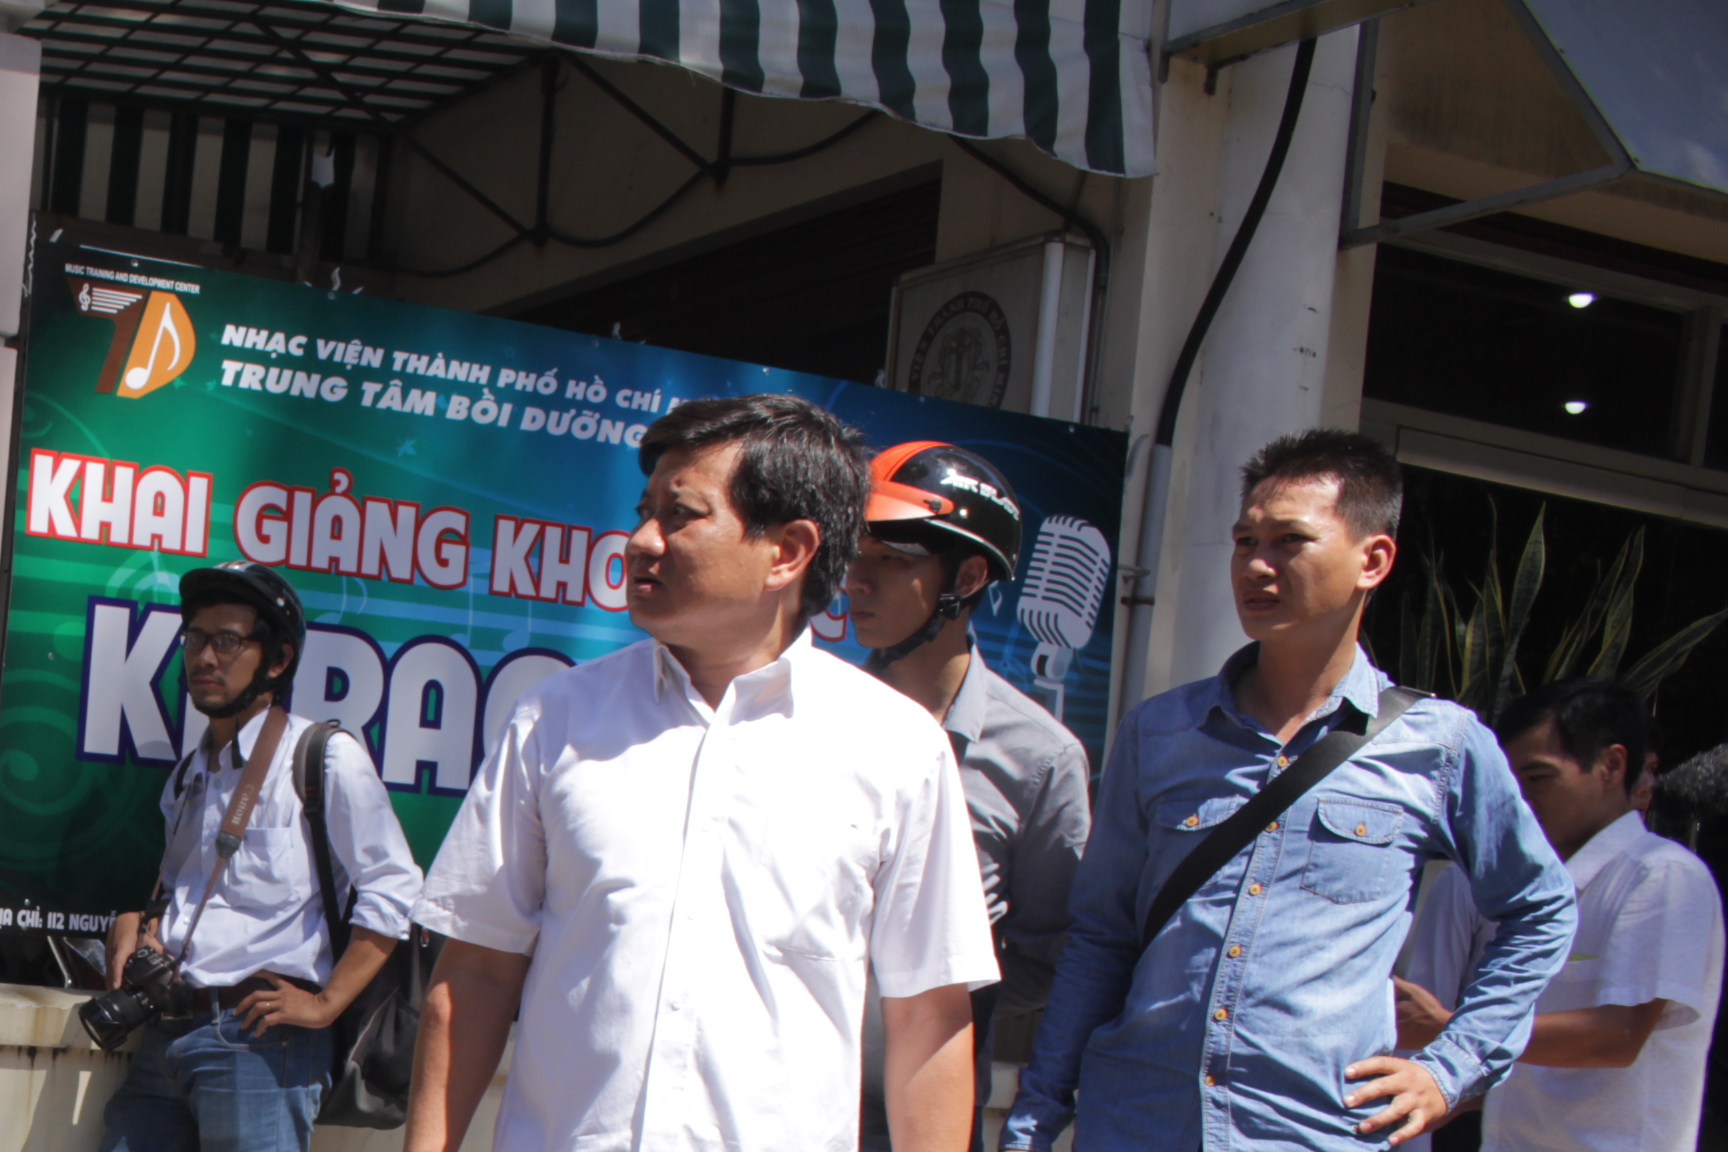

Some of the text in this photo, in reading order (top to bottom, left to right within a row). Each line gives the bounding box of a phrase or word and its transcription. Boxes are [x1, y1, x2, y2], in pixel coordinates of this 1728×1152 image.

[65, 263, 201, 295] MUSIC TRAINING AND DEVELOPMENT CENTER
[221, 323, 309, 359] NHẠC
[316, 338, 385, 371] VIỆN
[392, 352, 492, 385] THÀNH
[497, 367, 559, 396] PHỐ
[565, 374, 608, 404] HỒ
[615, 388, 663, 414] CHÍ
[221, 359, 649, 449] TRUNG TÂM BỒI DƯỠNG
[26, 448, 630, 612] KHAI GIẢNG KHO
[231, 783, 255, 826] Canon
[16, 905, 43, 929] CHỈ:
[47, 911, 66, 930] 112
[68, 910, 118, 933] NGUYỄ
